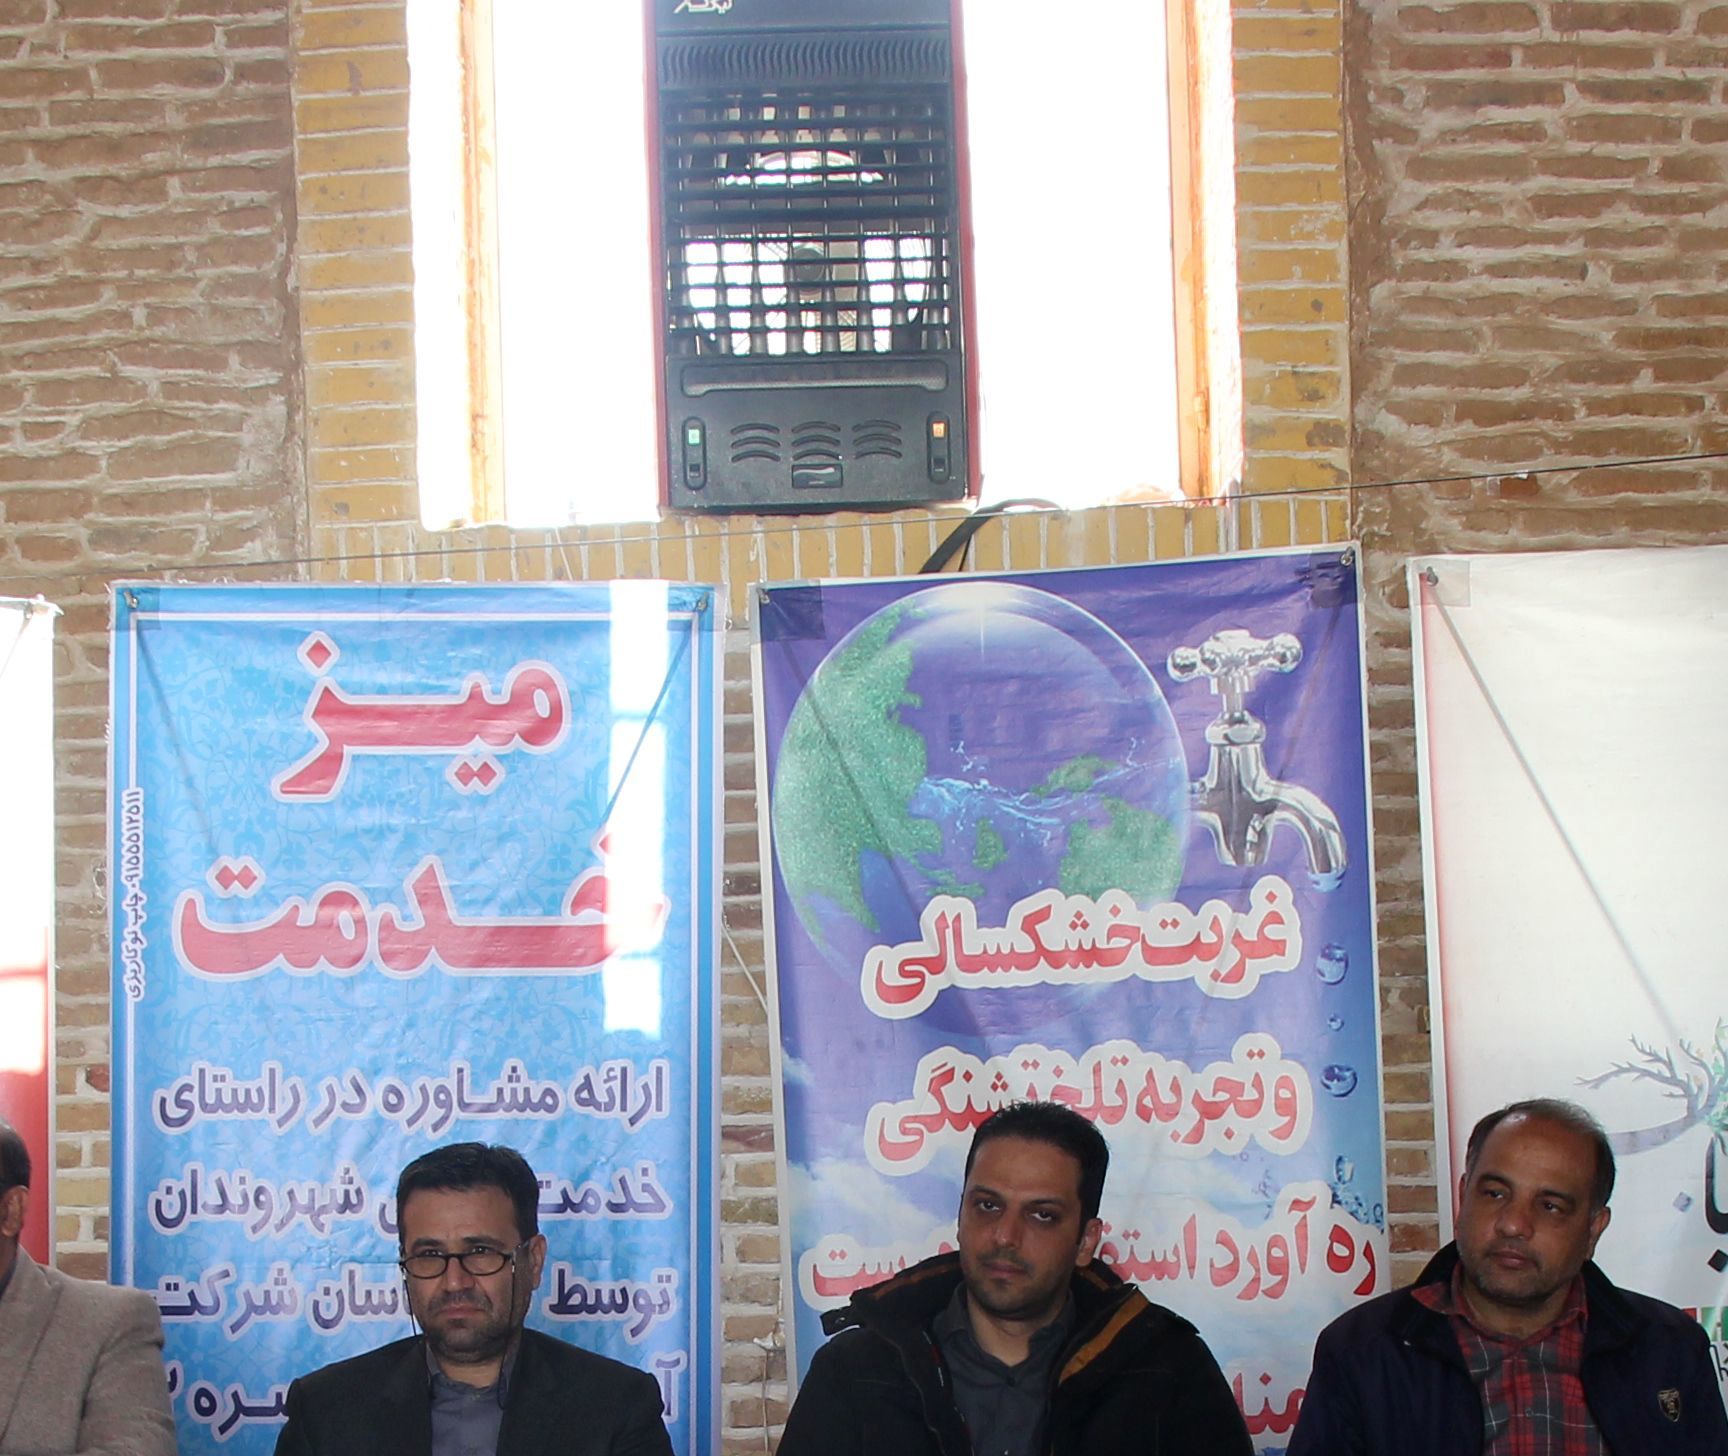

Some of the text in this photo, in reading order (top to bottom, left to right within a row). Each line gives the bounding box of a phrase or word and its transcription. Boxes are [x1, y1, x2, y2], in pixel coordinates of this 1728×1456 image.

[276, 636, 567, 797] میز
[874, 888, 1289, 1005] غربت خشکسالی
[159, 1064, 664, 1133] ارائه مشاوره در راستای
[1134, 1048, 1266, 1145] تجربه
[1268, 1073, 1300, 1143] و
[154, 1165, 365, 1234] شهروندان
[549, 1268, 672, 1340] توسط
